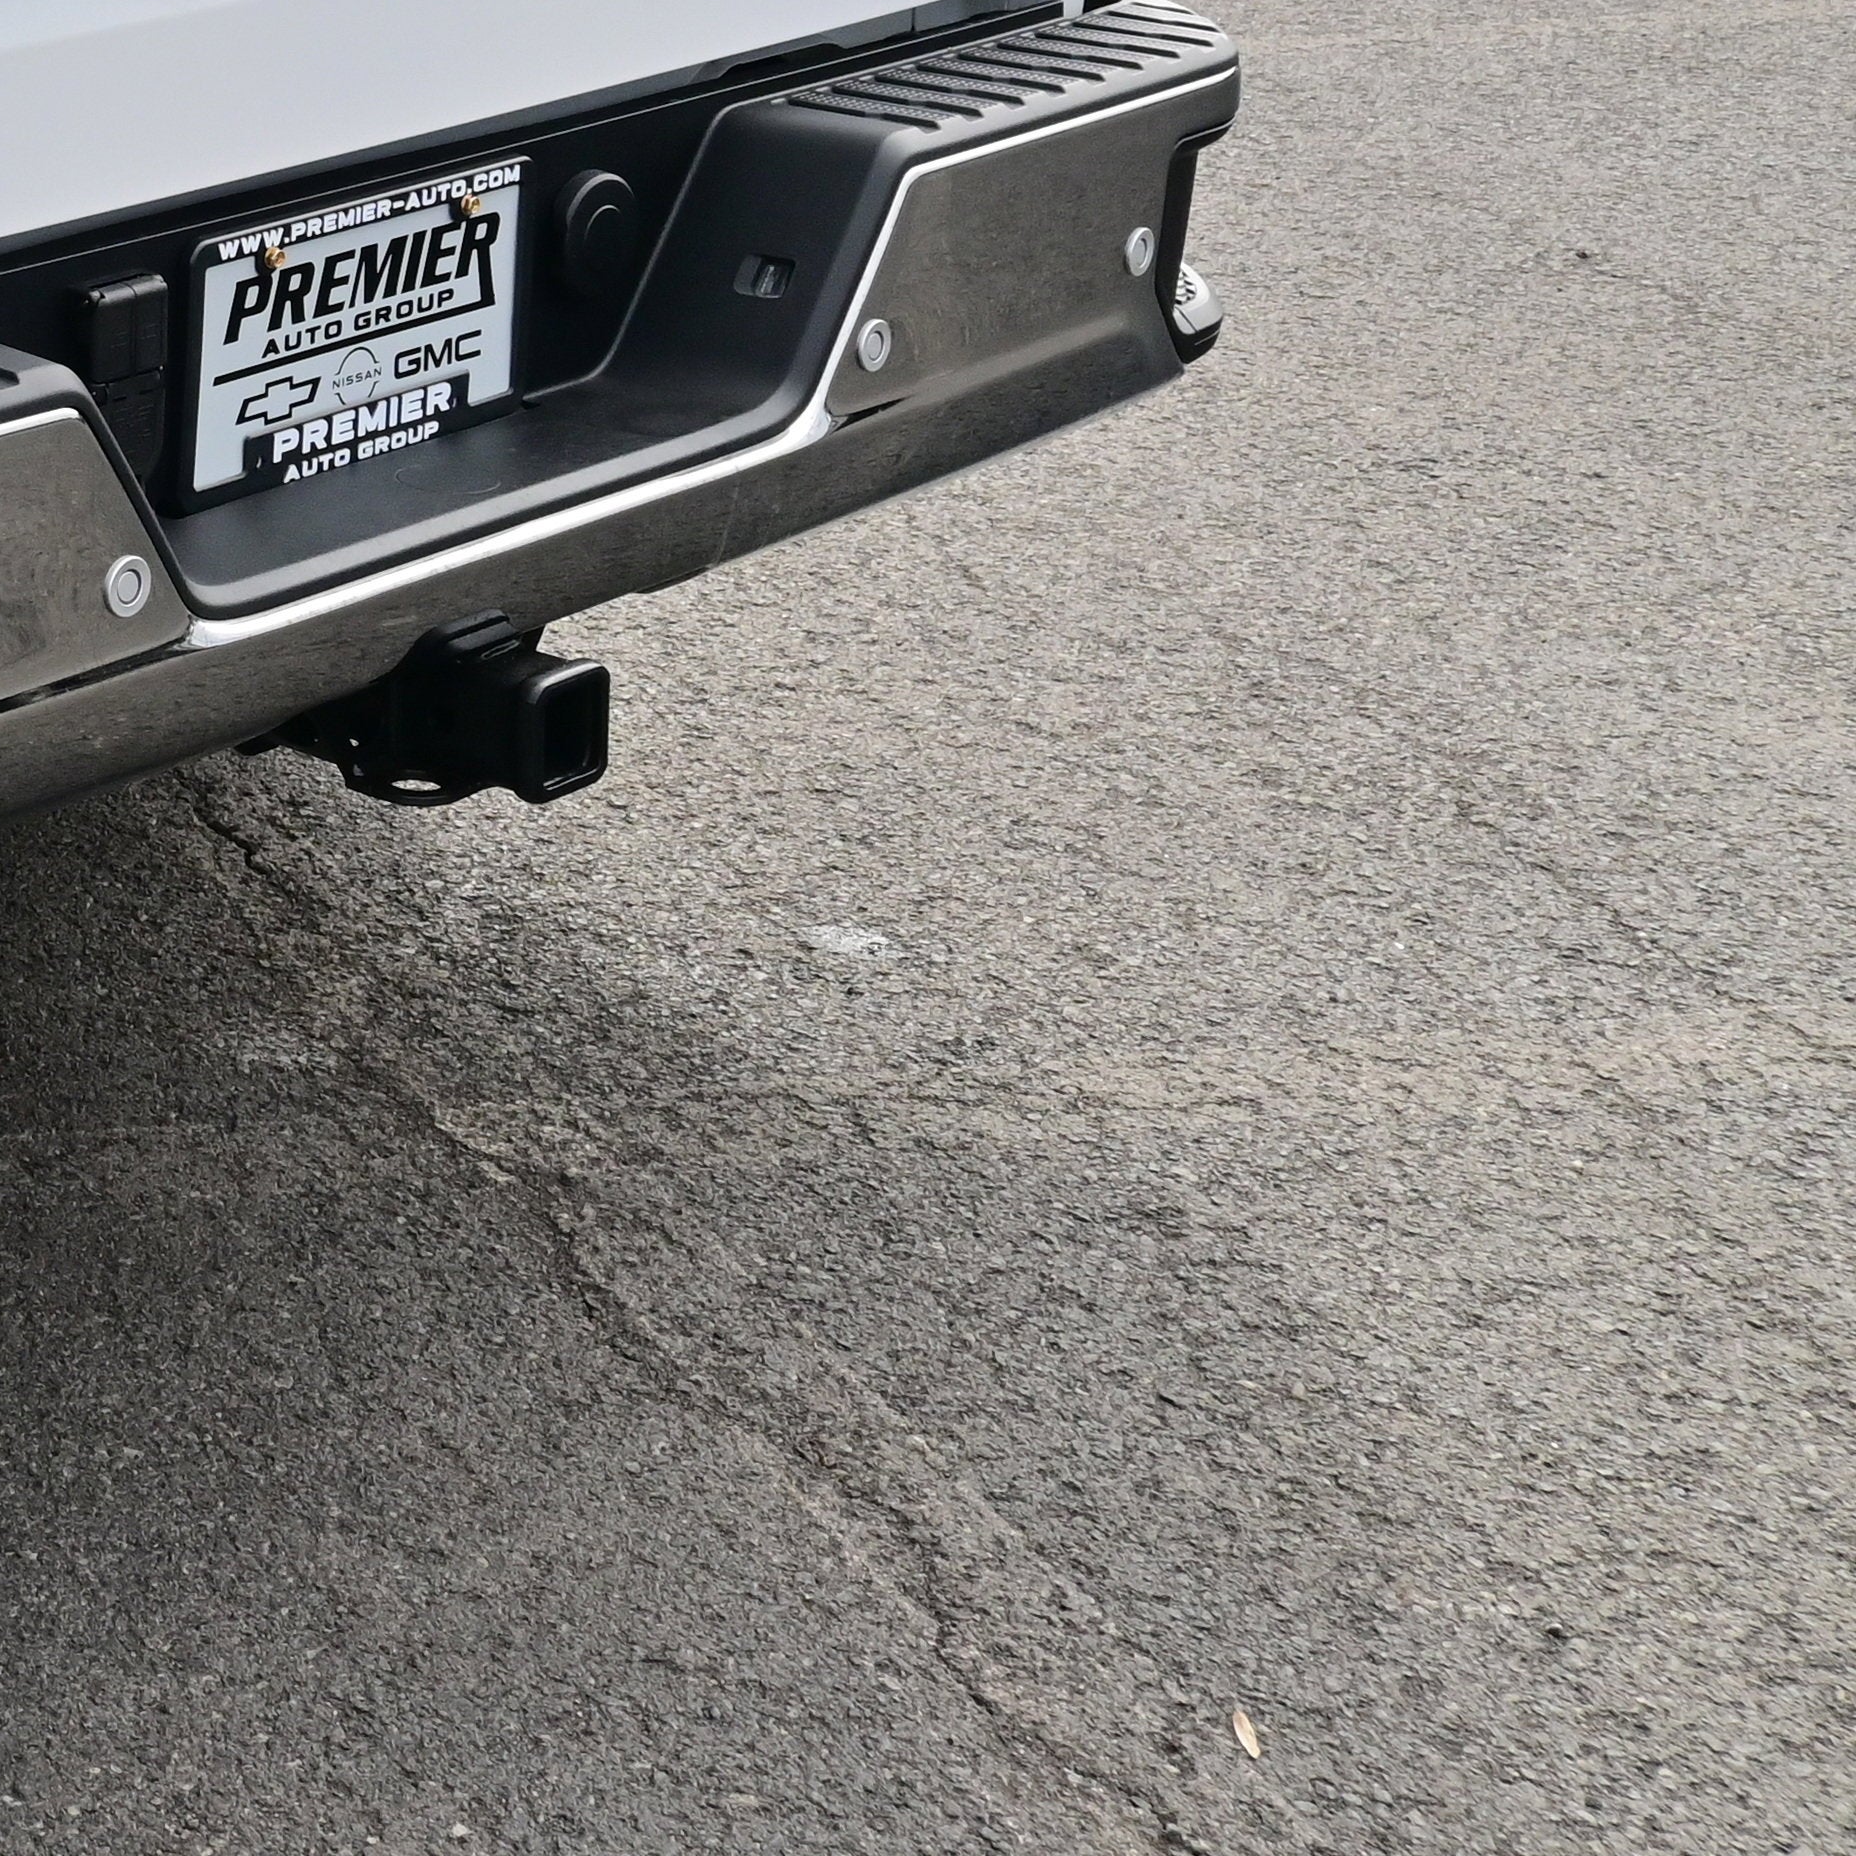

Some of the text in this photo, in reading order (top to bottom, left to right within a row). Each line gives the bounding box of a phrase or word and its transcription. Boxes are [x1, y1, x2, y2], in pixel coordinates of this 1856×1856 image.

[218, 164, 521, 261] WWW.PREMIER-AUTO.COM
[223, 211, 501, 346] PREMIER
[262, 288, 455, 359] AUTO GROUP
[332, 329, 483, 390] NISSAN GMC
[273, 381, 453, 464] PREMIER
[282, 420, 440, 484] AUTO GROUP
